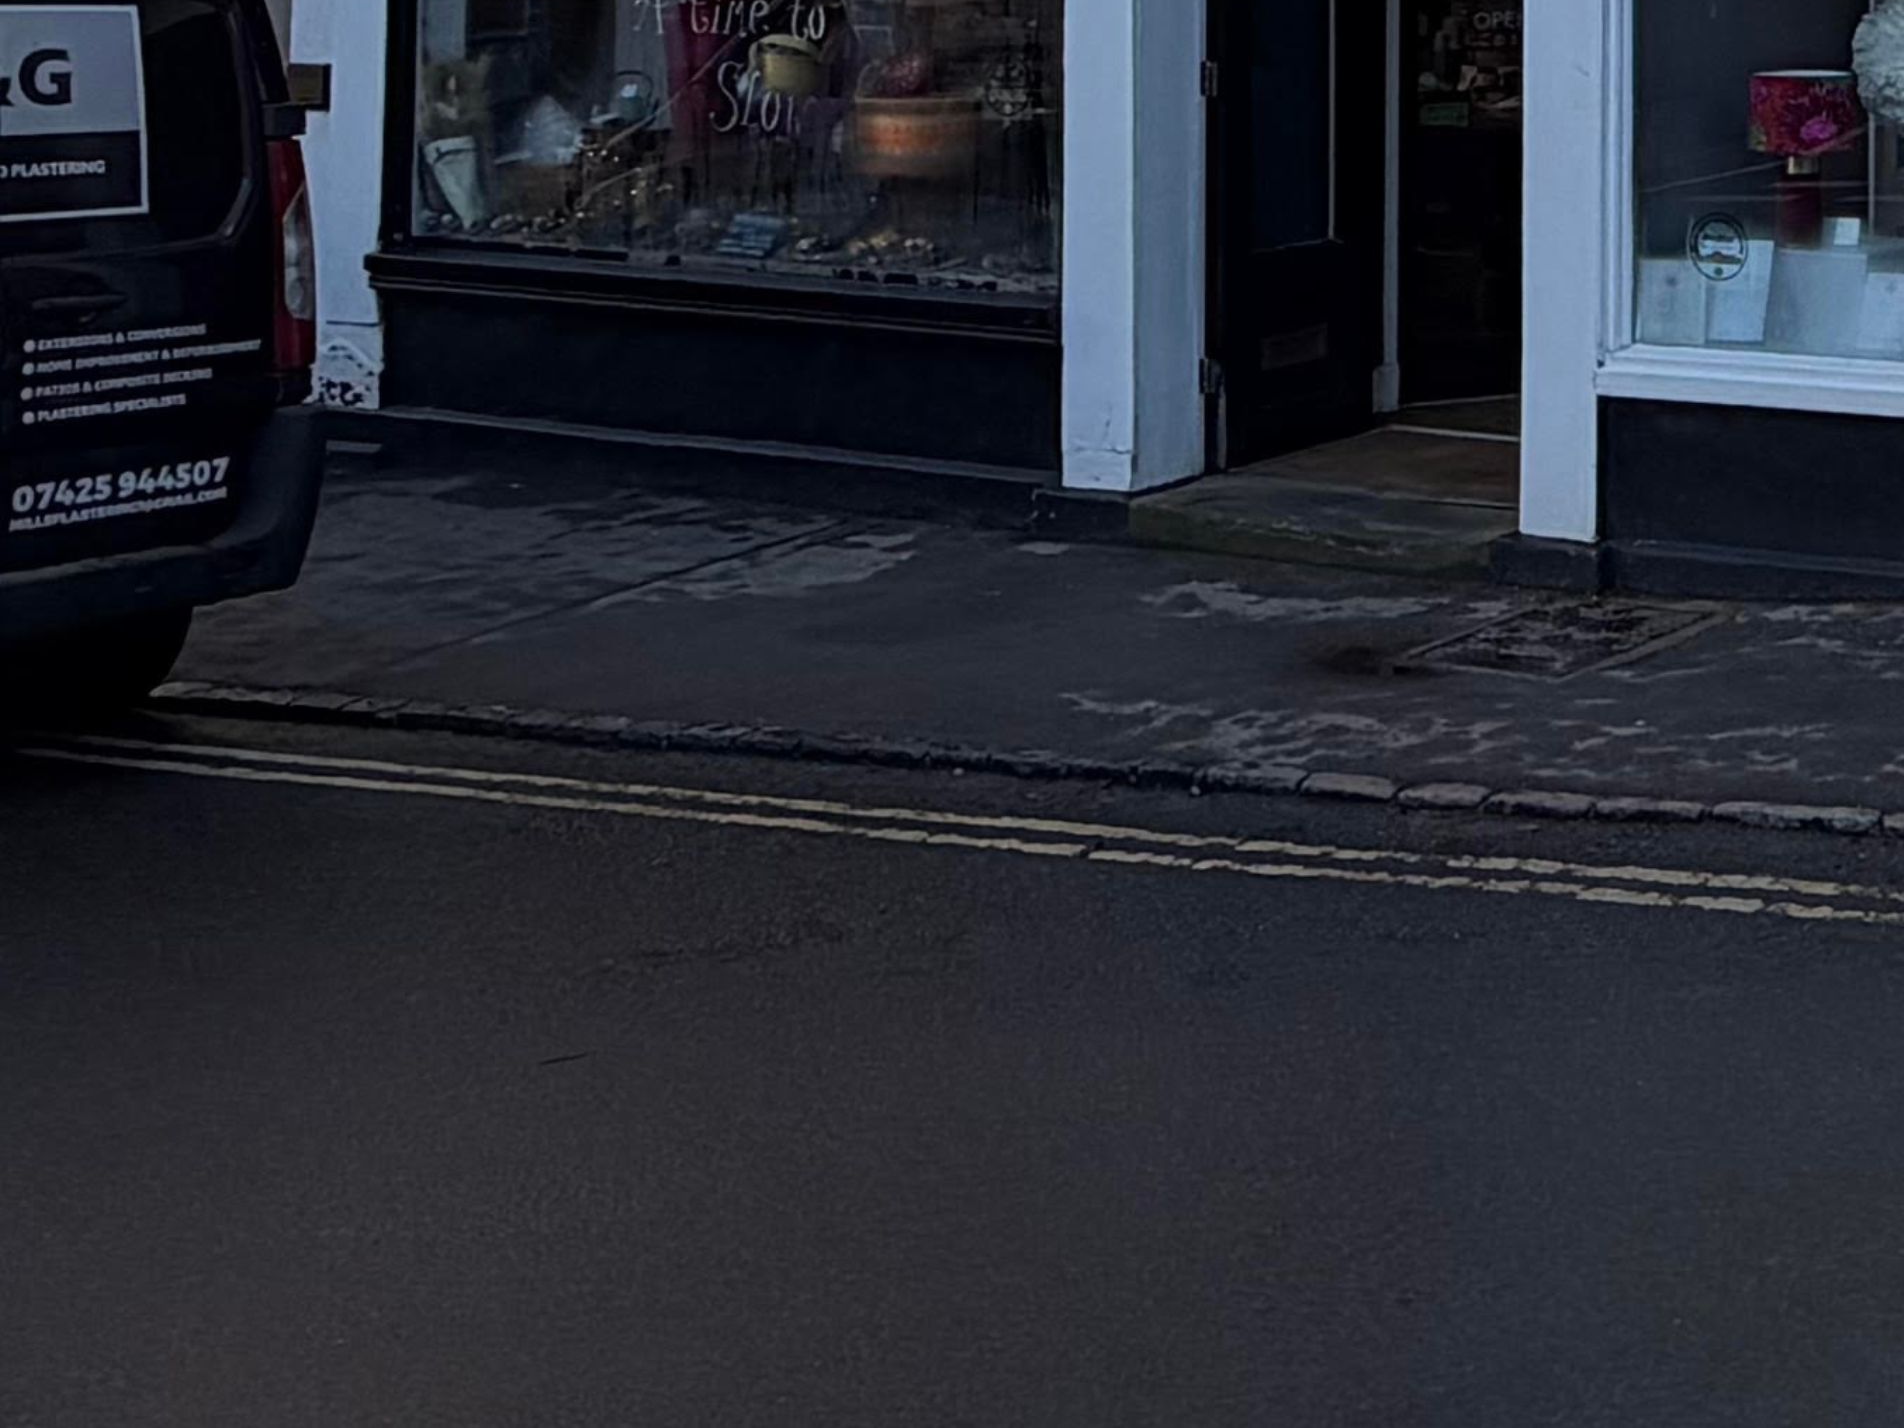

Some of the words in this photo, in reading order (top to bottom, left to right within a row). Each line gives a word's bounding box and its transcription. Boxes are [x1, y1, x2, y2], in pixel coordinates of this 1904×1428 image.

[1473, 10, 1521, 32] OPE
[10, 158, 107, 179] PLASTERING
[12, 473, 113, 513] 07425
[118, 456, 230, 499] 944507
